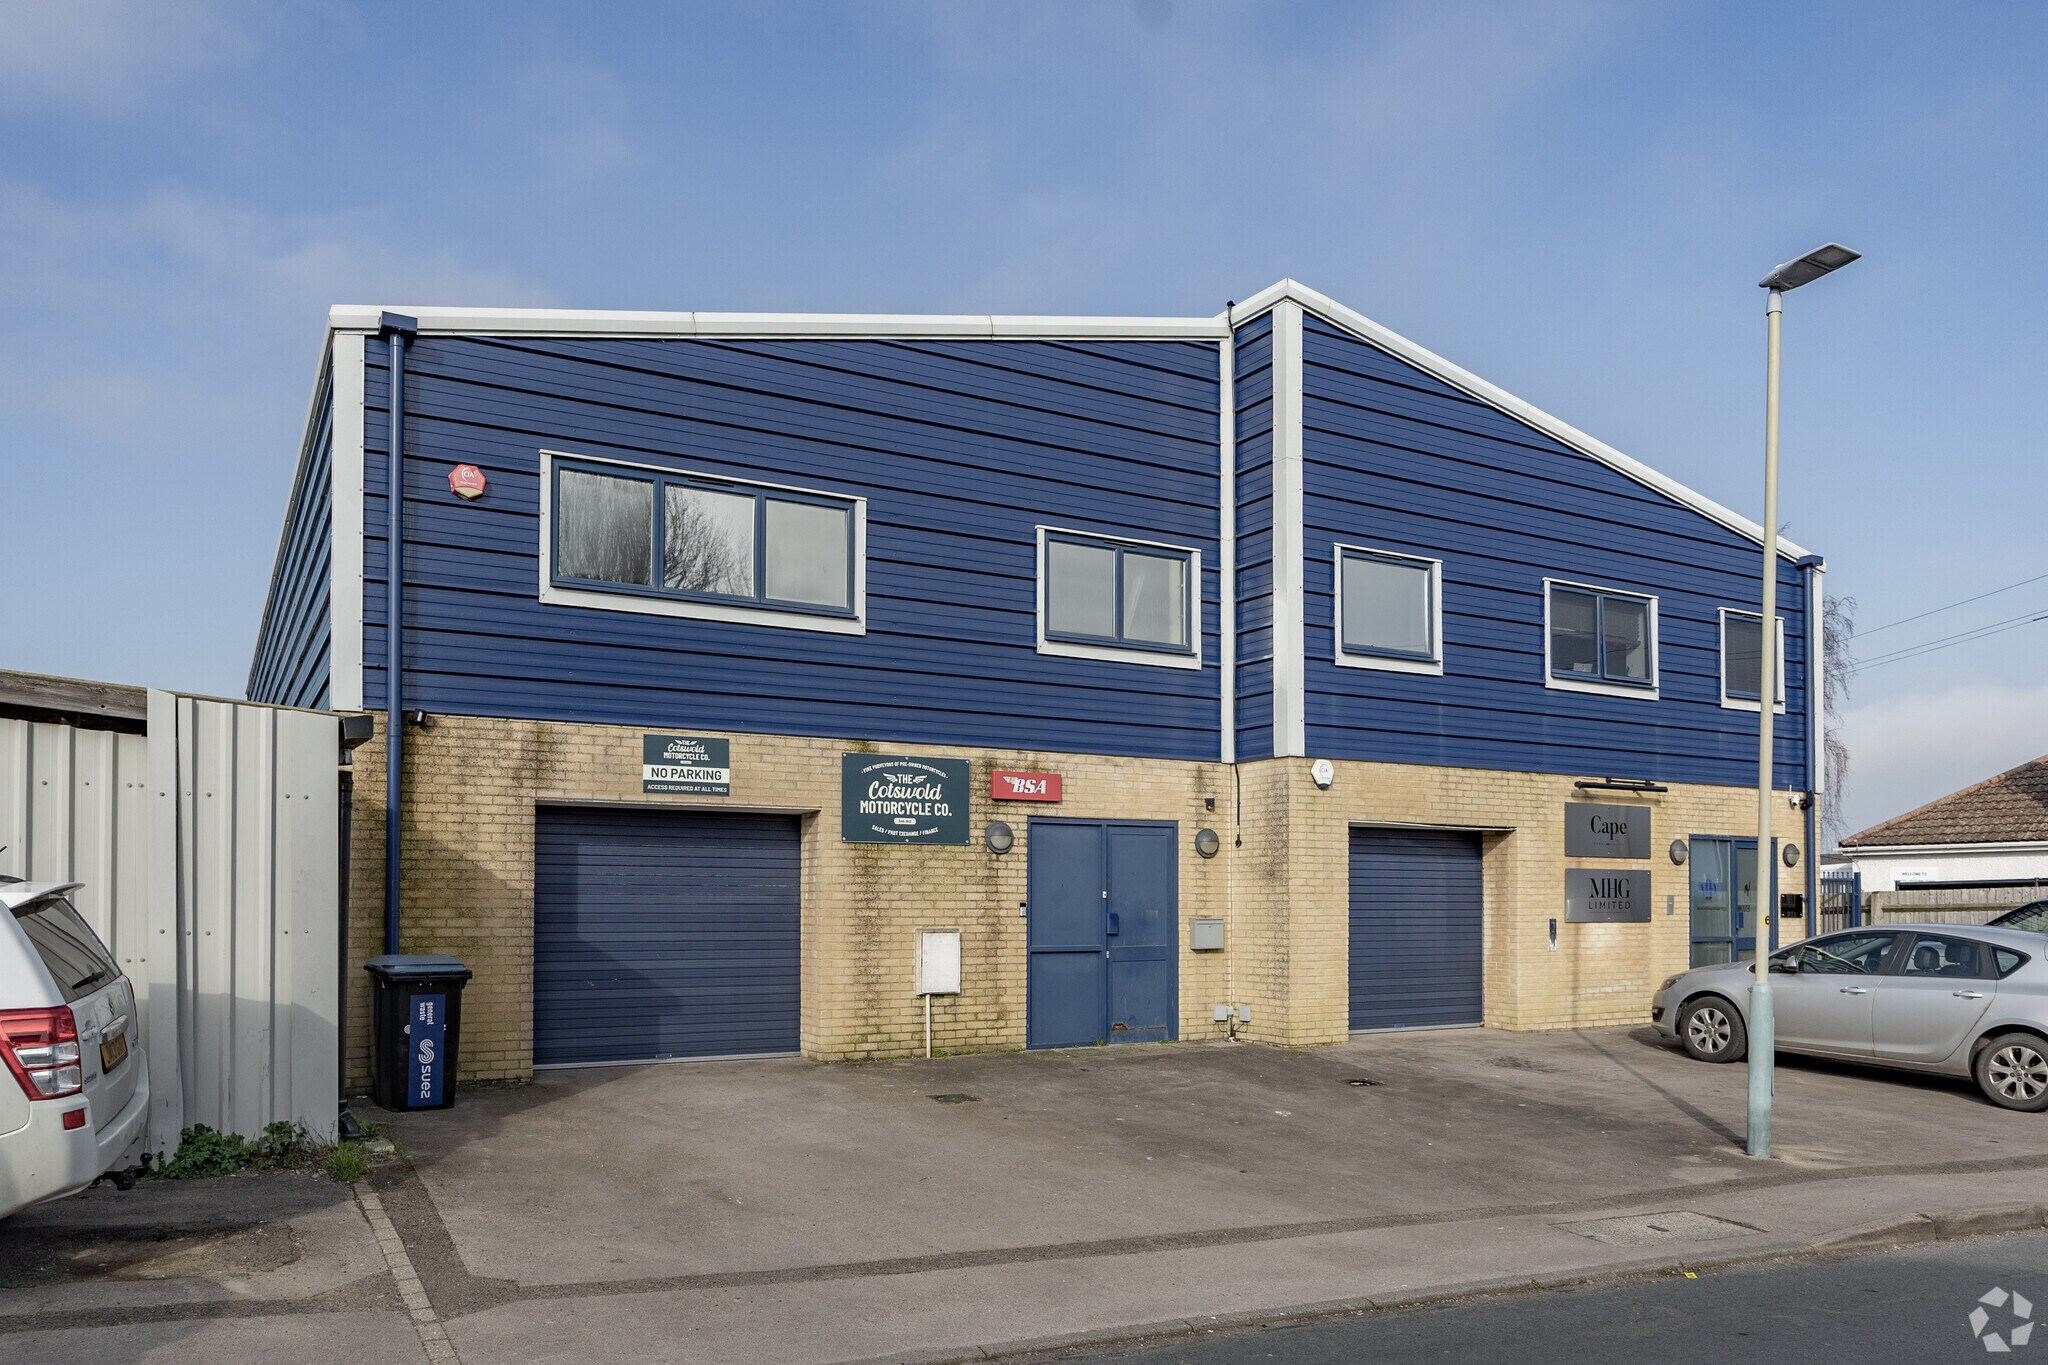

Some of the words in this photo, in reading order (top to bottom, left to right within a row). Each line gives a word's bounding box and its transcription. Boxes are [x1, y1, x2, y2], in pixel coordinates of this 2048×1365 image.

[664, 752, 700, 760] MOTORCYCLE
[668, 743, 705, 753] Cotswold
[652, 768, 667, 778] NO
[671, 769, 722, 780] PARKING
[872, 762, 894, 770] PURVEYORS
[922, 764, 947, 778] MOTORCYCLES
[897, 774, 913, 784] THE
[1012, 778, 1046, 794] BSA
[868, 781, 942, 800] Cotswold
[860, 800, 932, 815] MOTORCYCLE
[934, 803, 952, 816] CO.
[872, 824, 884, 833] SALES
[1591, 815, 1627, 840] Cape
[1590, 878, 1630, 898] MHG
[1588, 901, 1631, 910] LIMITED
[426, 1002, 434, 1025] general
[421, 1065, 431, 1099] suez
